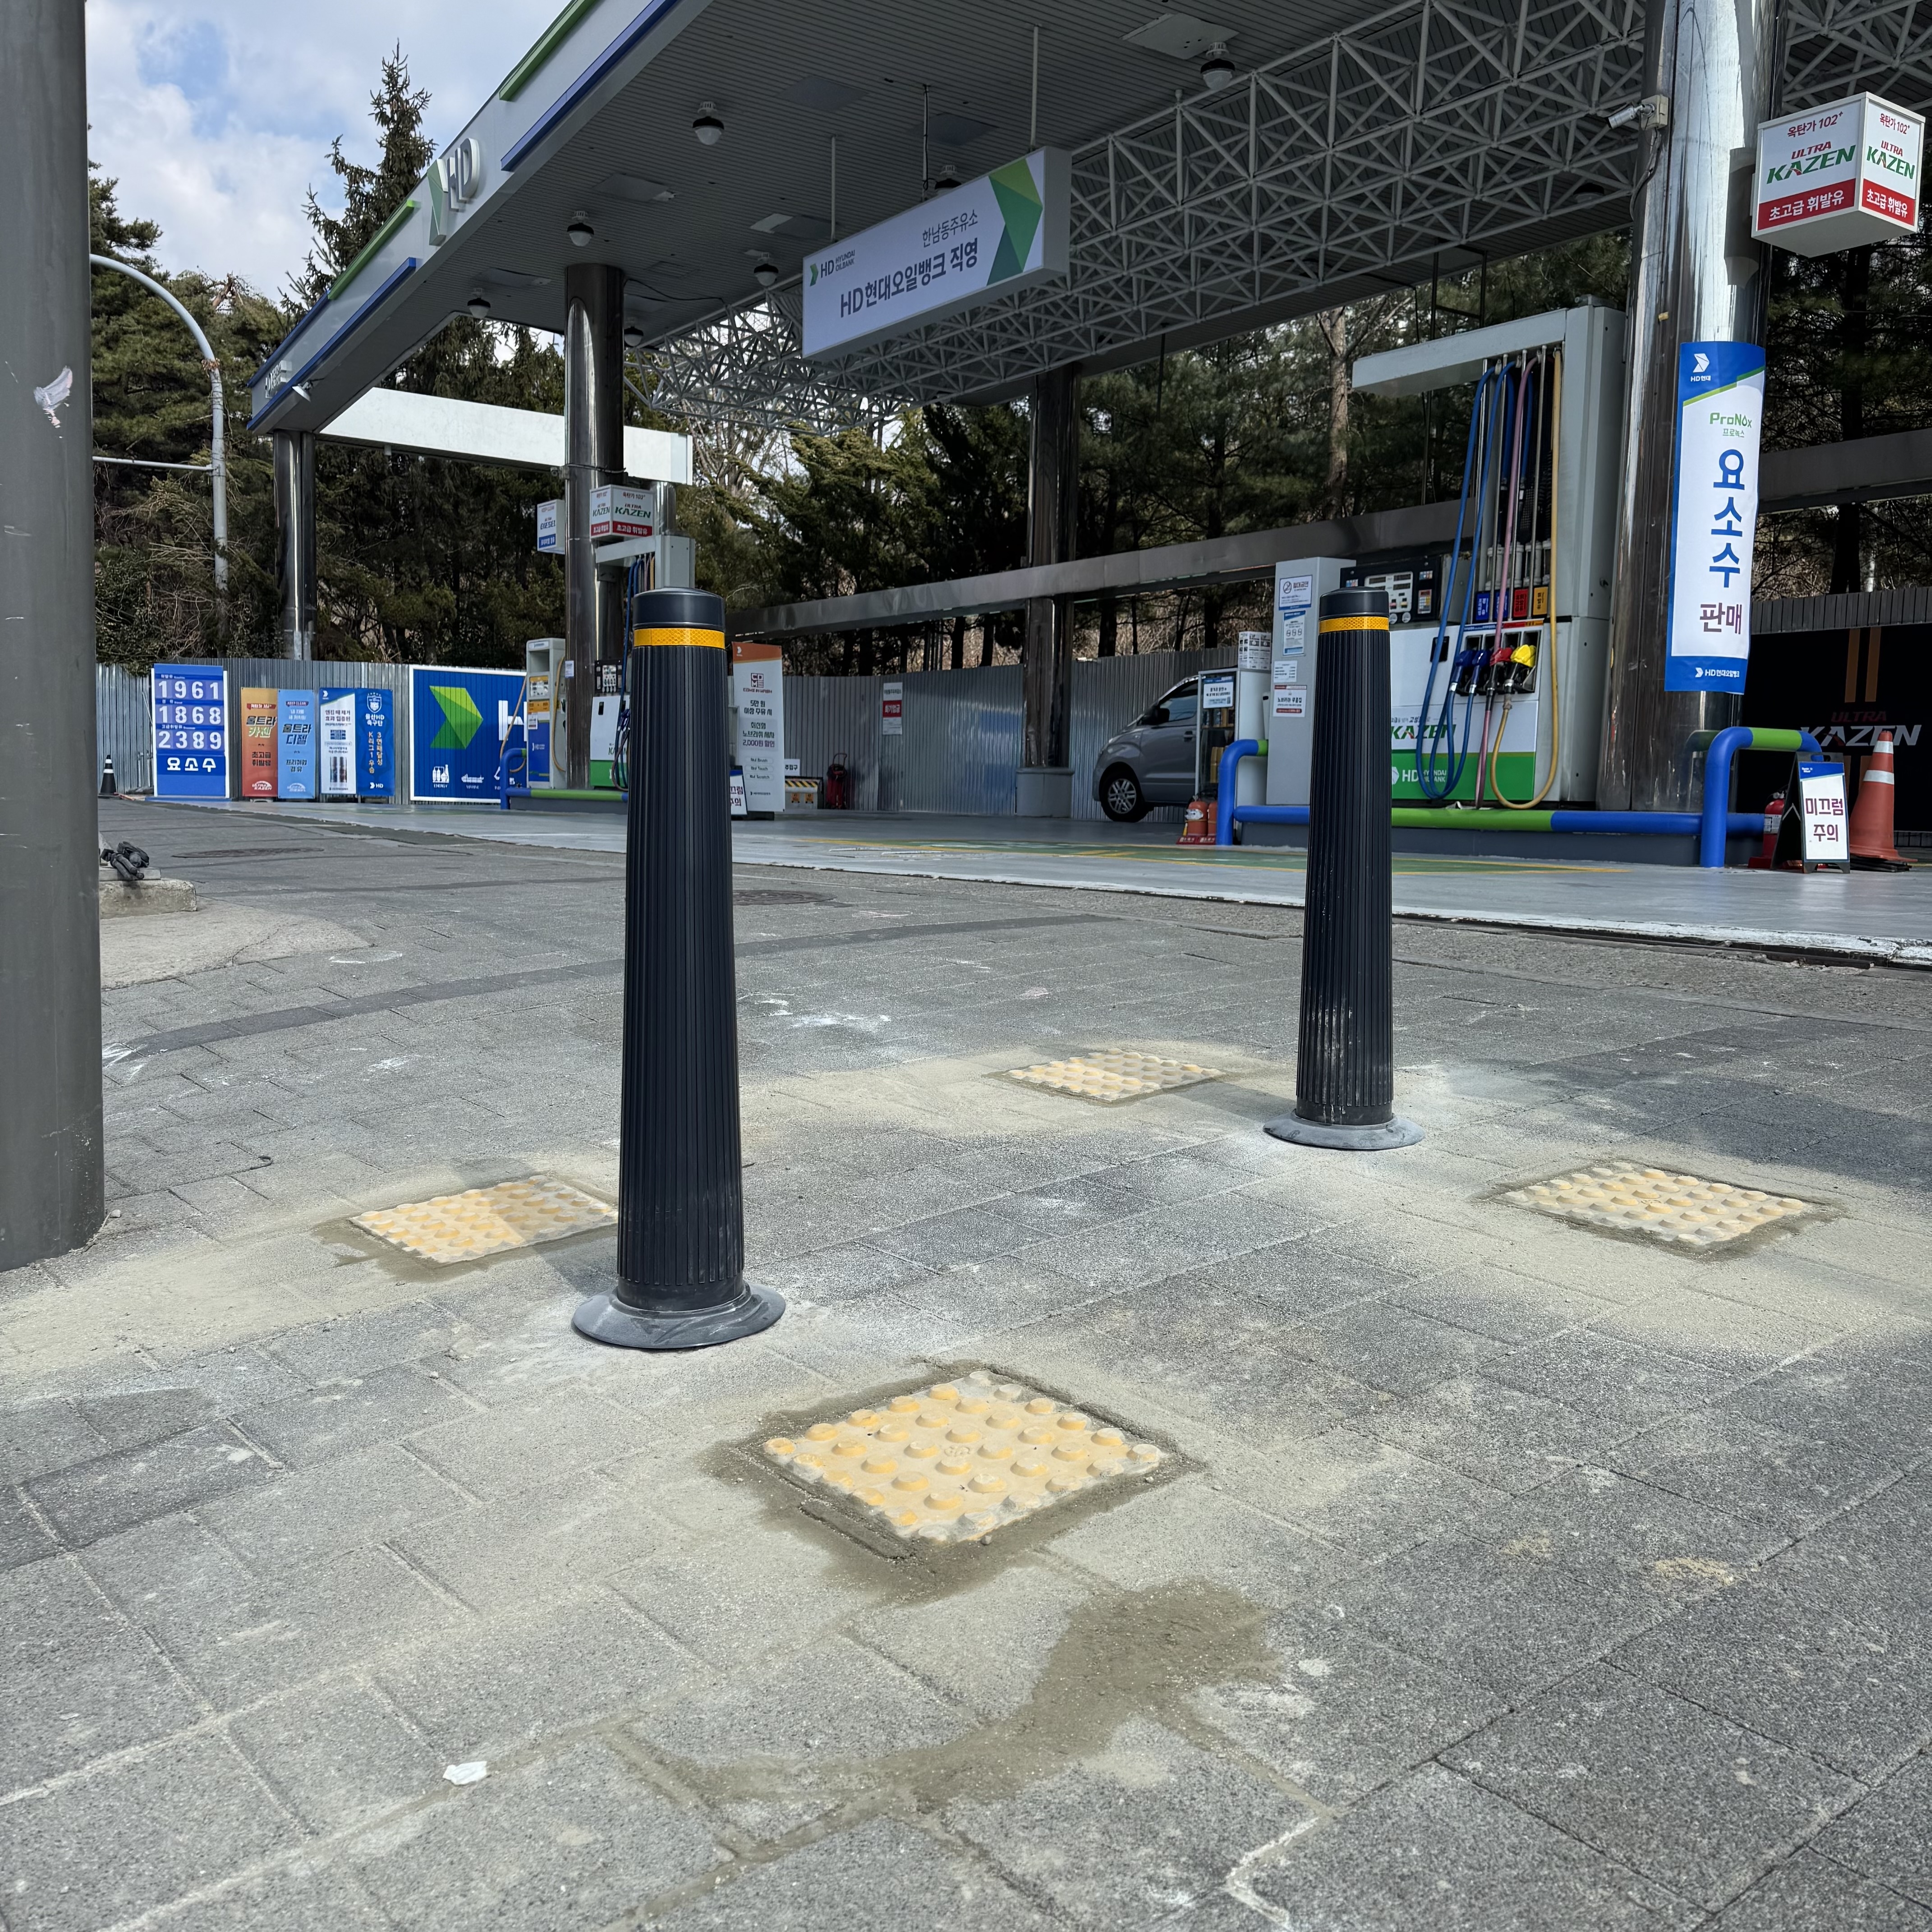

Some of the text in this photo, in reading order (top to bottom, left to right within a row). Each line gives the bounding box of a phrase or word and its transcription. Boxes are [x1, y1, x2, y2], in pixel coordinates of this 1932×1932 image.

[1787, 111, 1843, 138] 옥탄가 102+
[1880, 113, 1896, 130] 옥탄가
[1791, 141, 1831, 159] ULTRA
[1881, 140, 1903, 156] ULTRA
[1766, 145, 1856, 184] KAZEN
[1867, 146, 1915, 179] KAZEN
[447, 138, 476, 211] HD
[1769, 190, 1844, 221] 초고급 휘발유
[1866, 189, 1908, 218] 초고급 휘발유
[923, 209, 978, 248] 한남동주유소
[820, 249, 855, 278] HD HYUNDAI
[835, 258, 855, 271] OILBANK
[841, 237, 978, 318] HD현대오일뱅크 직영
[1722, 428, 1744, 437] 프로녹스
[593, 506, 610, 517] KAZEN
[615, 507, 651, 518] KAZEN
[1709, 449, 1745, 588] 요소수
[540, 520, 556, 529] DIESEL
[616, 524, 647, 535] 초고급 휘발유
[1700, 603, 1742, 635] 판매
[159, 681, 218, 699] 1961
[159, 706, 221, 724] 1868
[885, 704, 900, 713] 화기엄금
[1831, 711, 1887, 722] ULTRA
[246, 716, 277, 727] 울트라
[283, 723, 312, 734] 울트라
[158, 731, 221, 750] 2389
[286, 734, 308, 745] 디젤
[167, 757, 216, 772] 요소수
[1402, 769, 1419, 782] HD
[730, 786, 743, 795] 끄럼
[1805, 798, 1843, 815] 미끄럼
[1813, 824, 1838, 842] 주의
